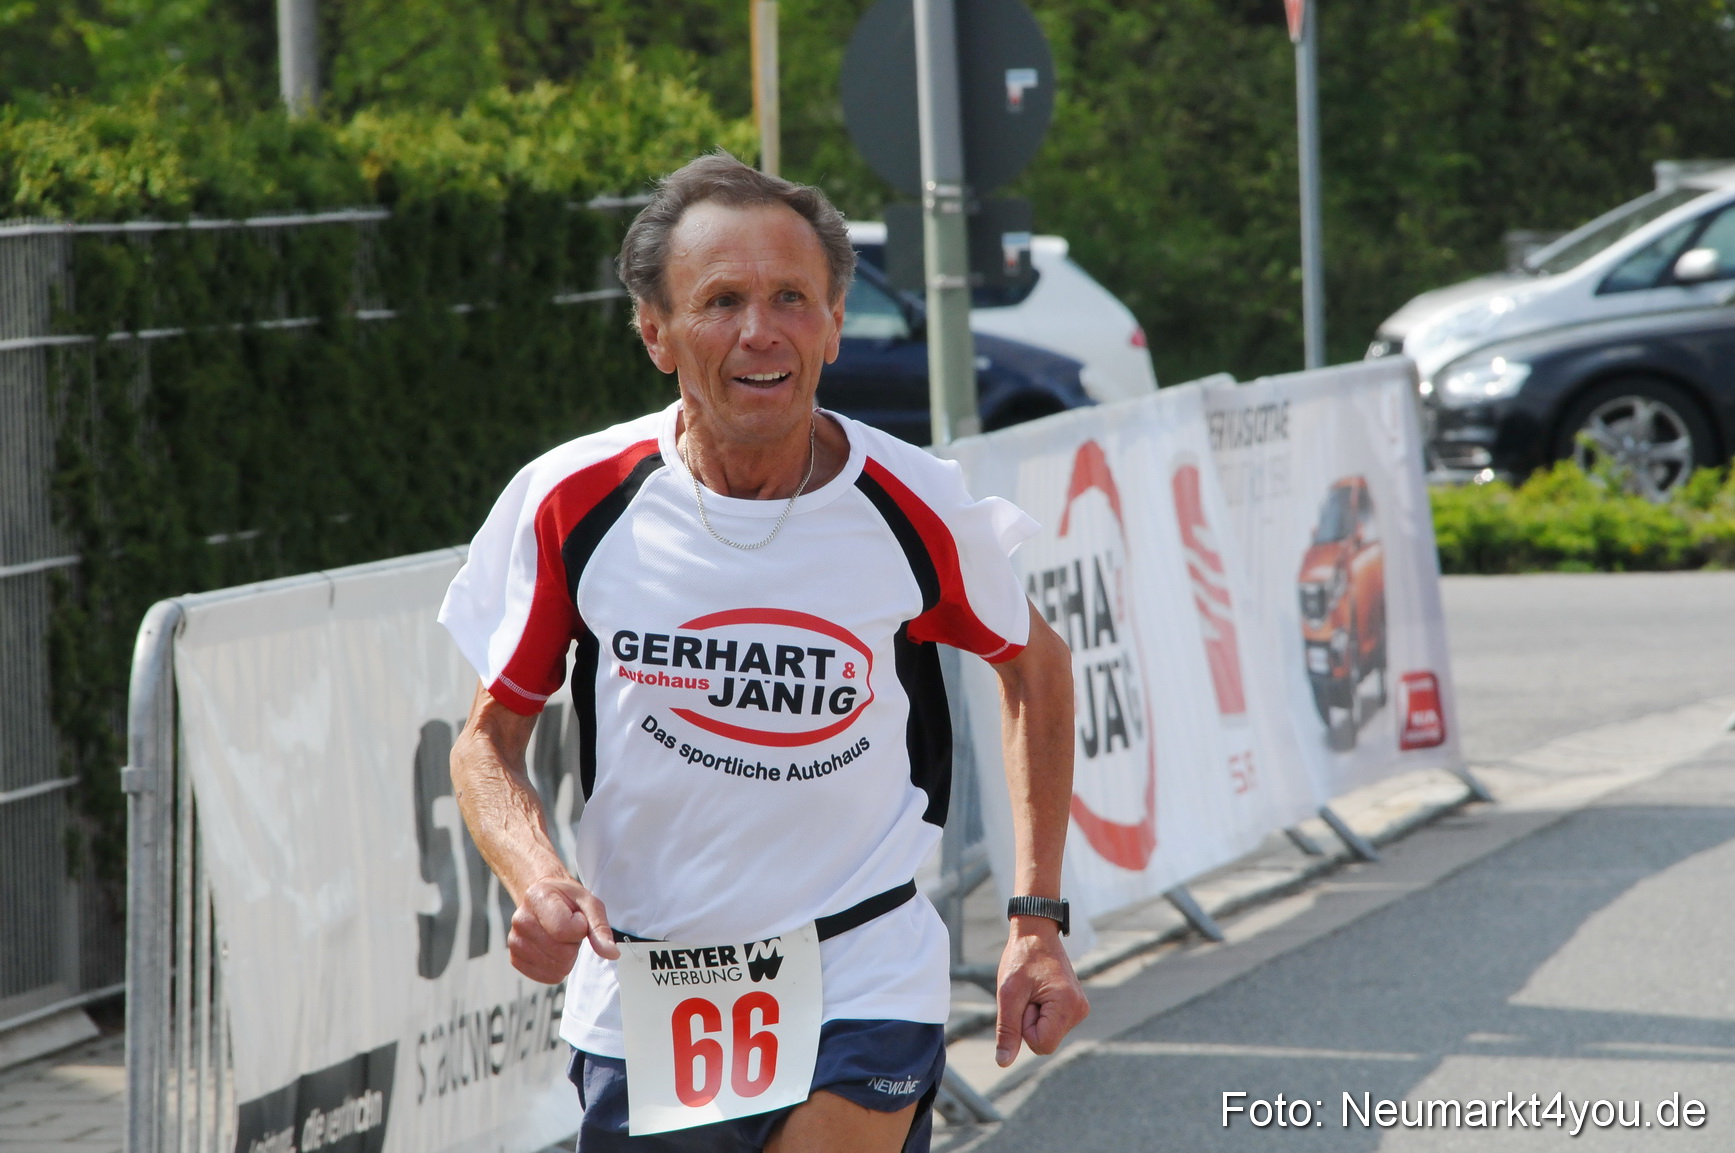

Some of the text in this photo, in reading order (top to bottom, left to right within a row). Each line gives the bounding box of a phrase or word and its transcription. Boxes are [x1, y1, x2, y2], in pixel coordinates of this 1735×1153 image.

[612, 630, 856, 680] GERHART &
[618, 664, 710, 691] Autohaus
[708, 676, 857, 715] JÄNIG
[641, 715, 871, 782] Das sportliche Autohaus
[649, 945, 739, 970] MEYER
[652, 967, 743, 986] WERBUNG
[671, 991, 780, 1108] 66
